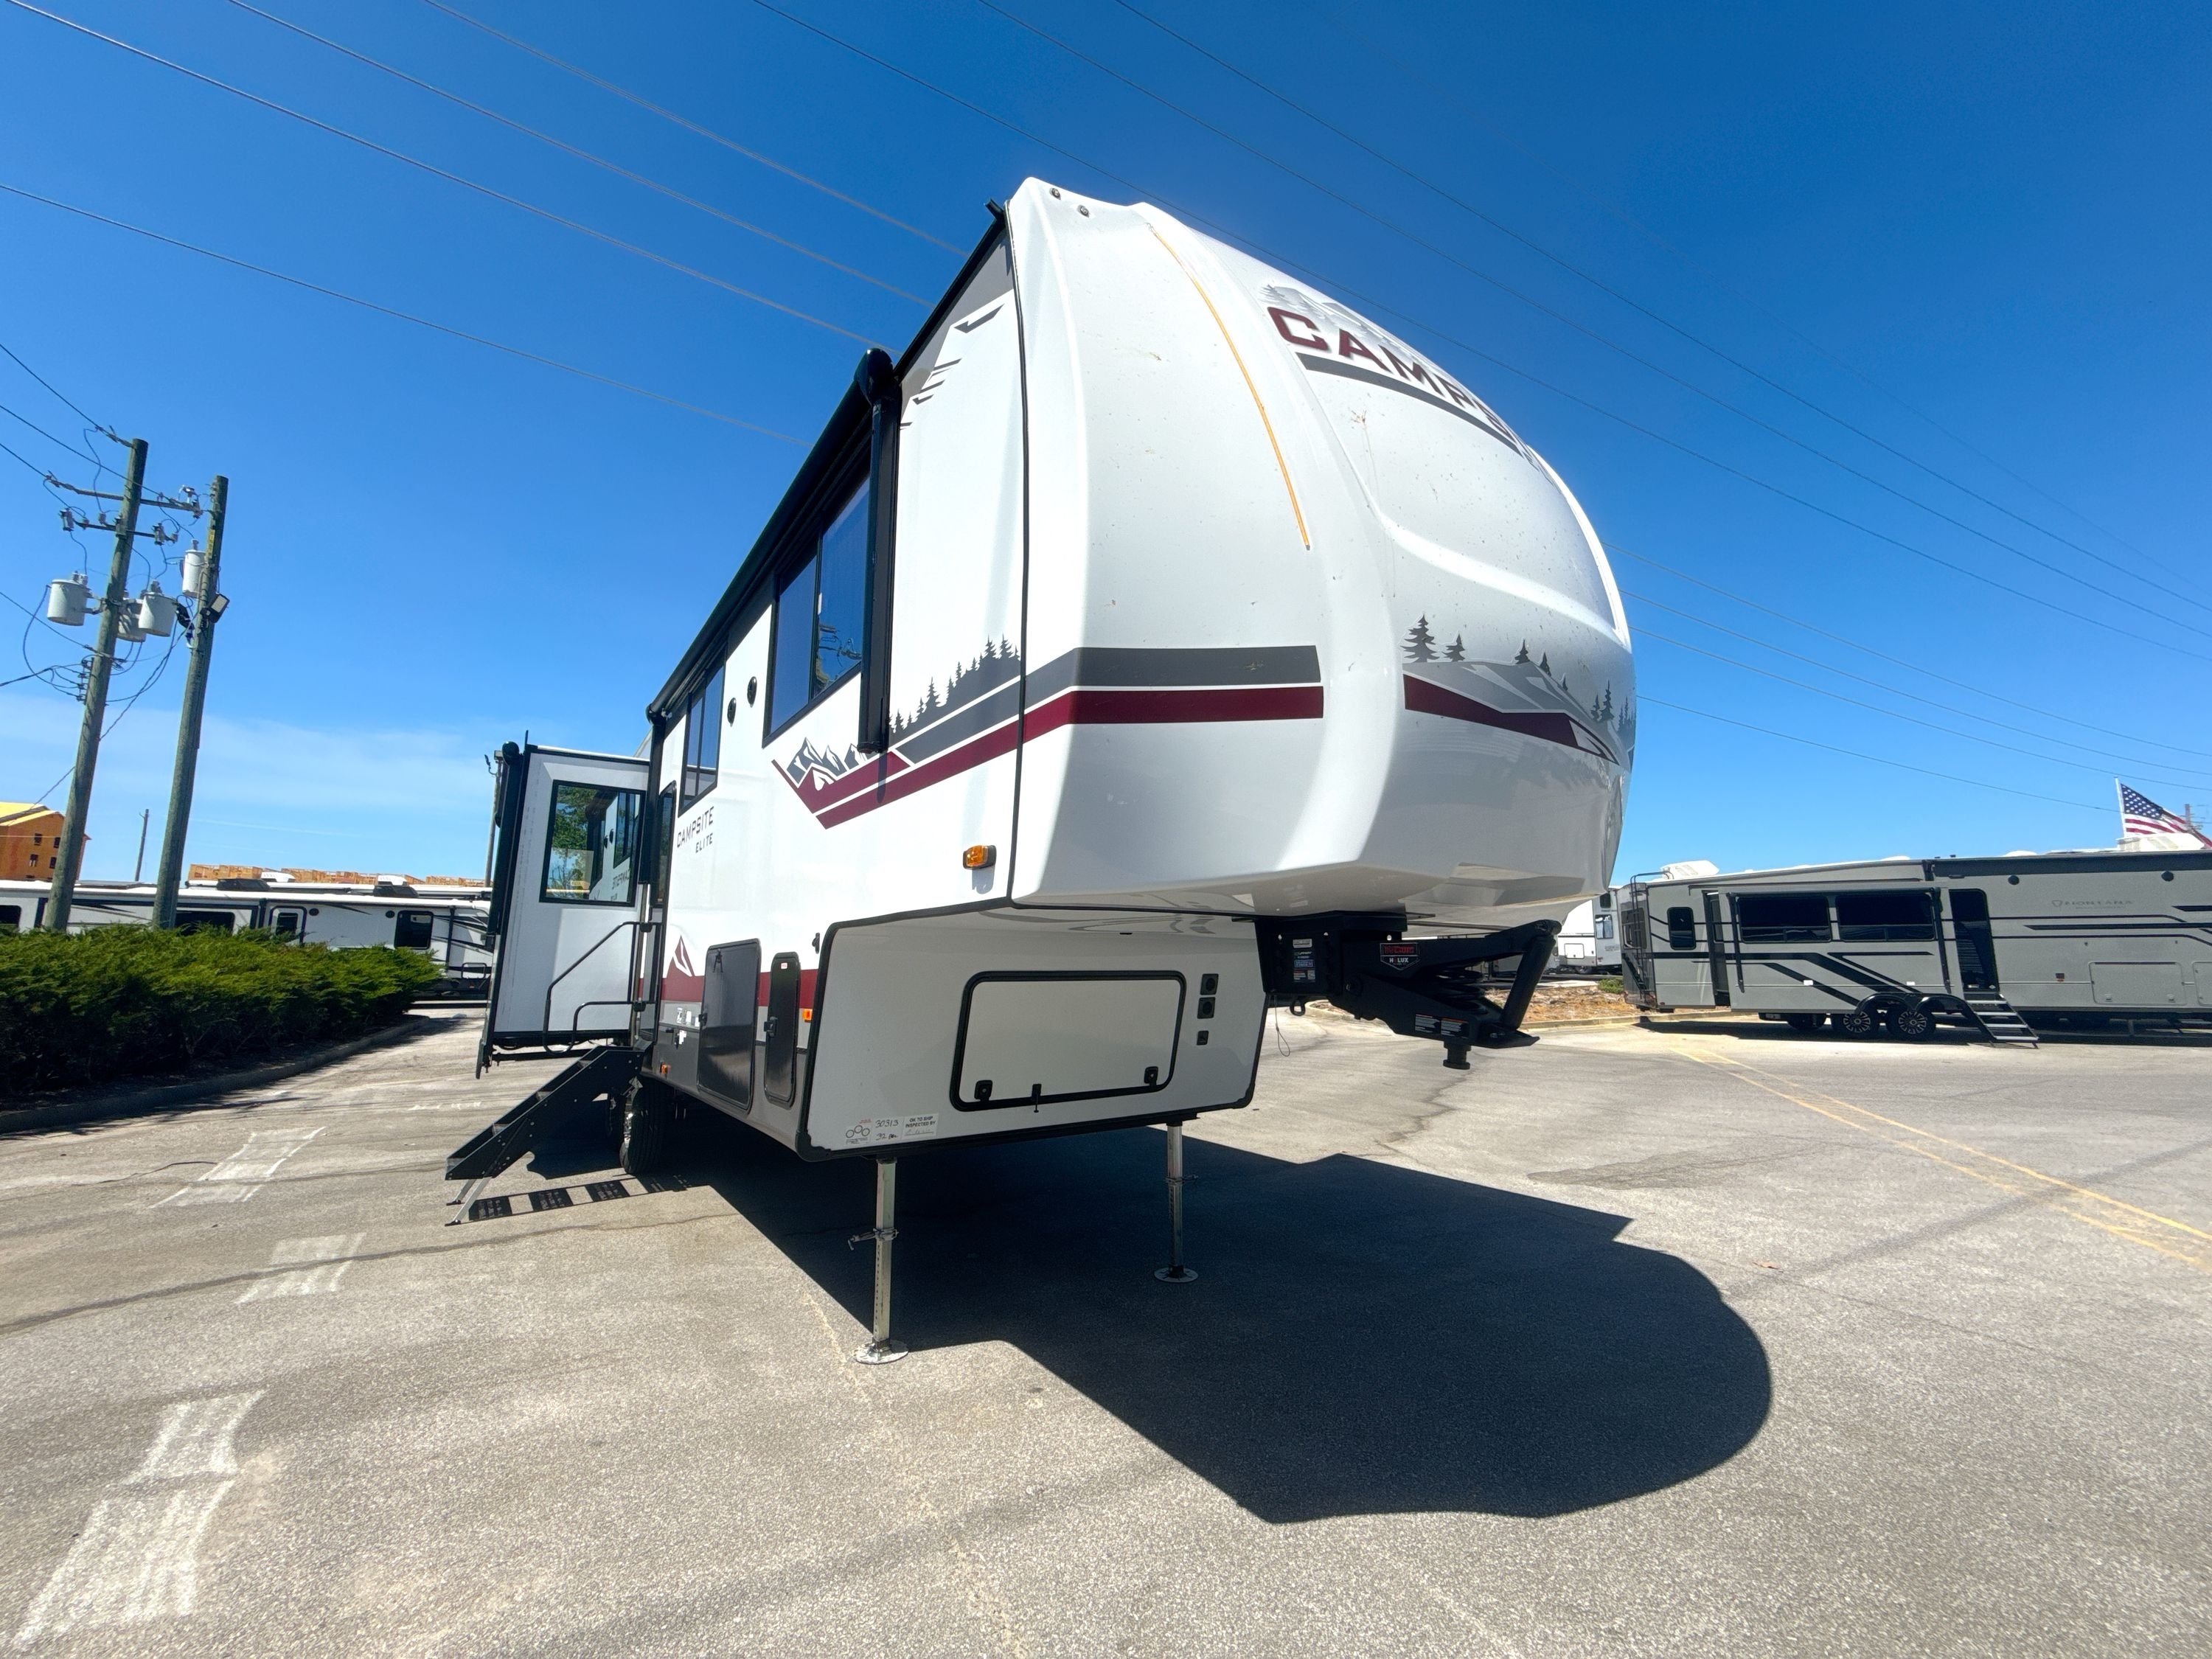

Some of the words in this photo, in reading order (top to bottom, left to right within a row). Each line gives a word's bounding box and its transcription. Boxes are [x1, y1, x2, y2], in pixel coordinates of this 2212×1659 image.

[1267, 306, 1534, 458] CAMPS
[677, 806, 714, 848] CAMPSITE
[695, 832, 713, 854] ELITE
